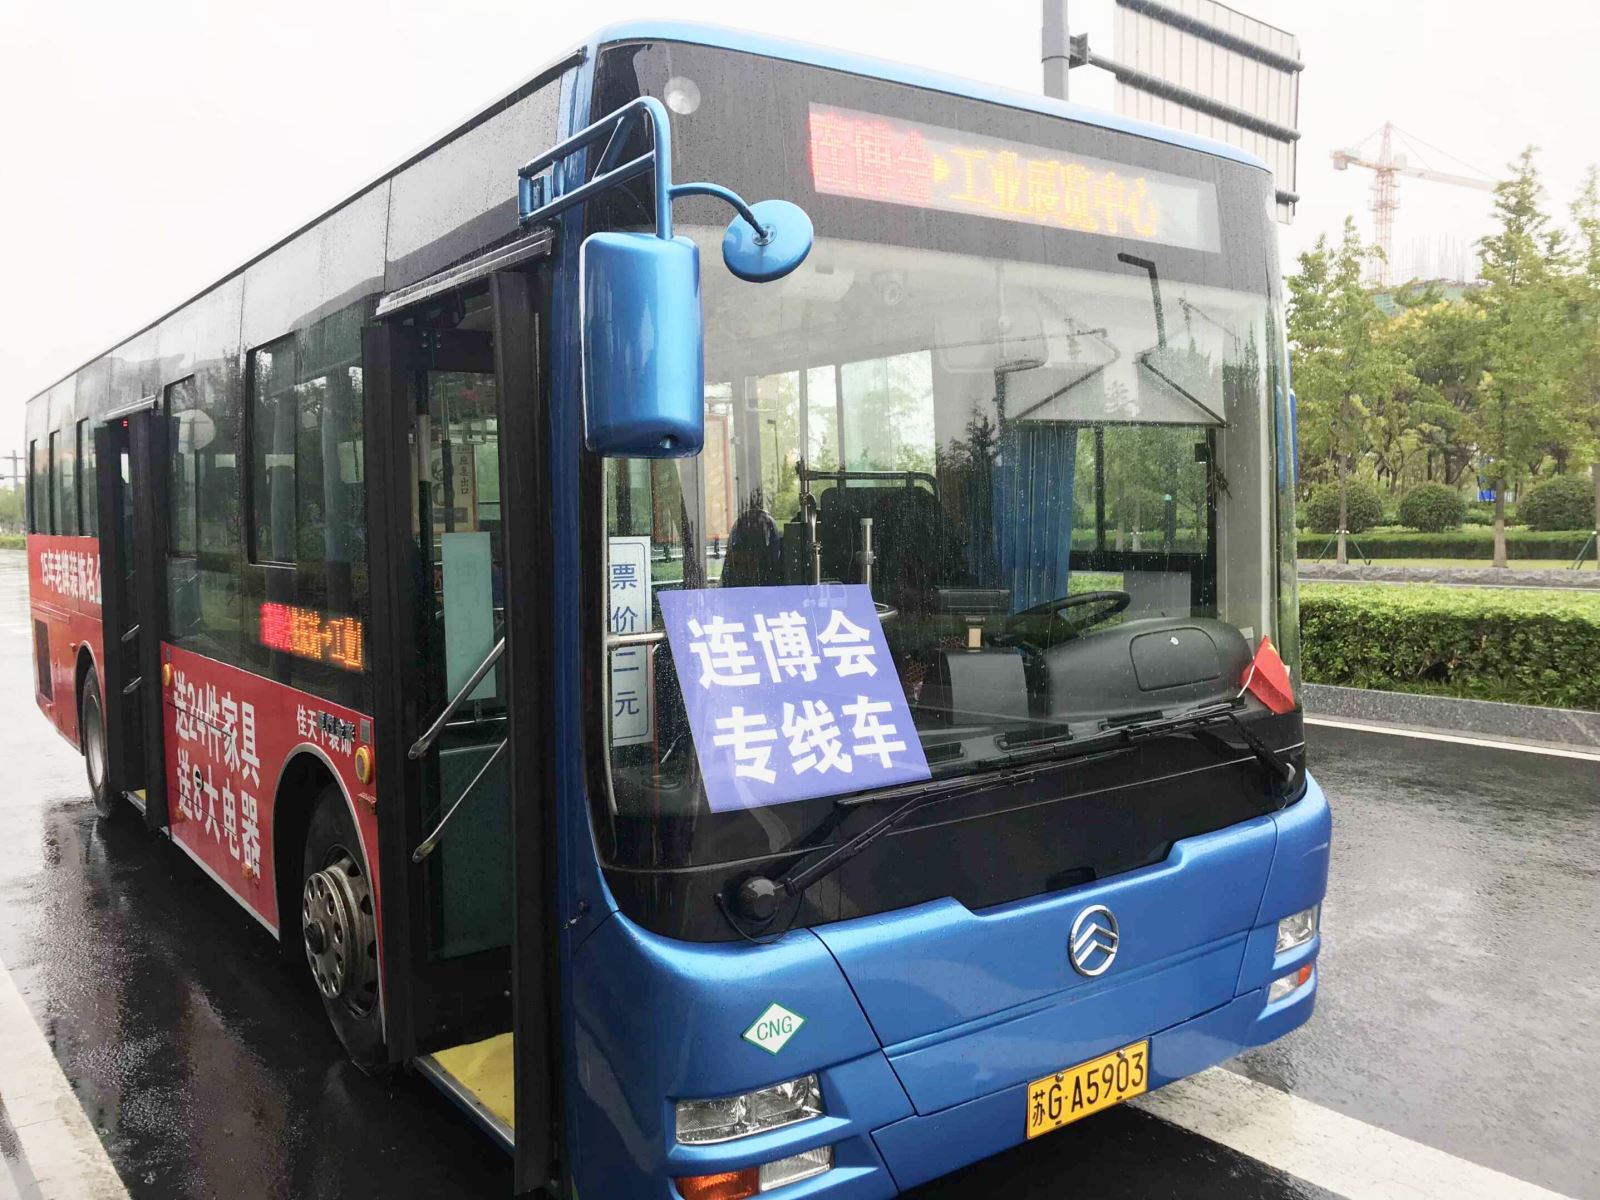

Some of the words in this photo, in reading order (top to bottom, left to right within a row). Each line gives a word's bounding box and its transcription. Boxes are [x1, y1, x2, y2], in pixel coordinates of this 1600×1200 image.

[611, 563, 639, 717] 票价二元
[687, 609, 878, 690] 连博会
[174, 670, 260, 789] 送24件家具
[713, 696, 907, 784] 专线车
[177, 748, 261, 879] 送8大电器
[757, 1016, 792, 1040] CNG
